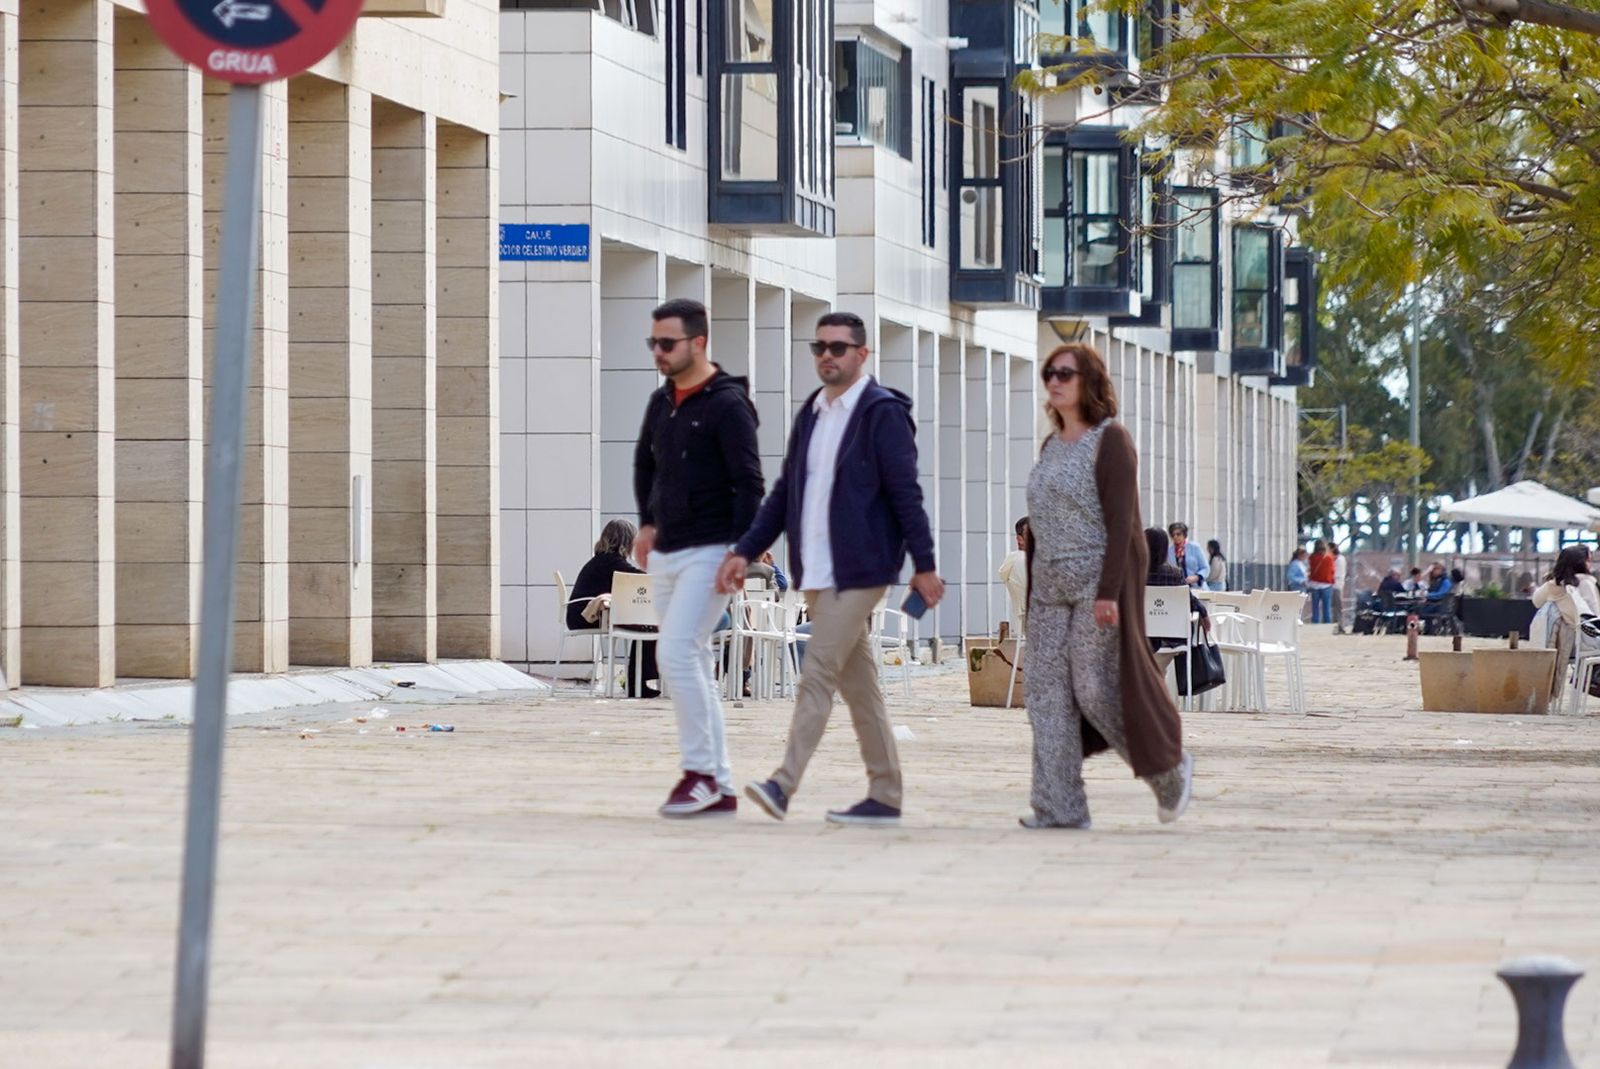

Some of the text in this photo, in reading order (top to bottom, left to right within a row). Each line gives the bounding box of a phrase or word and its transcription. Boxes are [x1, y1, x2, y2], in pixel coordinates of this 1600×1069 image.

[207, 49, 276, 75] GRUA
[525, 230, 551, 240] CALLE
[522, 244, 558, 256] CELESTINO
